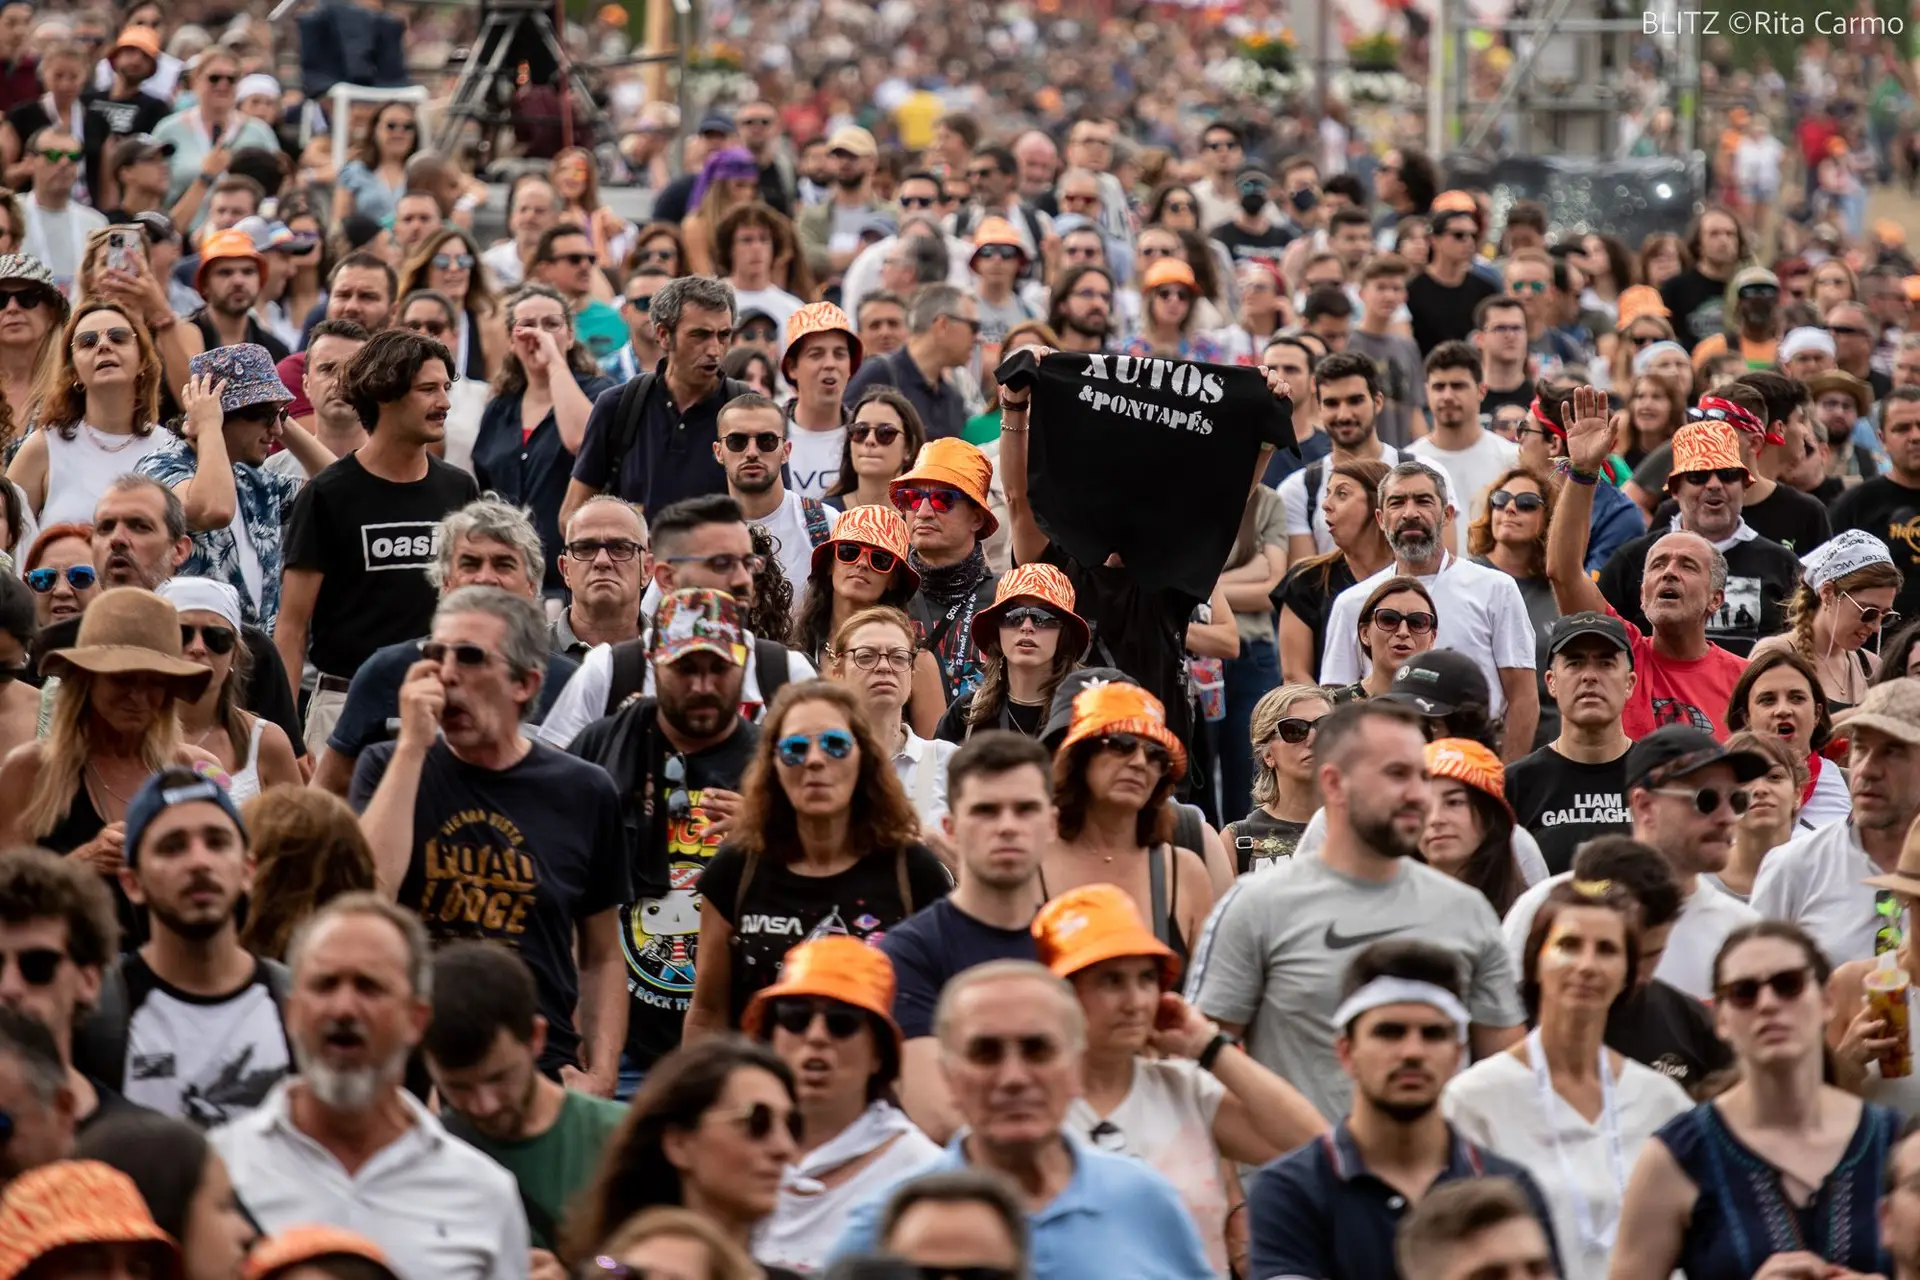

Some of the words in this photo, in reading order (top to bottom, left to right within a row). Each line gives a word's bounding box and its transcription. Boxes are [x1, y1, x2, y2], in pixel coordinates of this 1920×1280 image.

[1081, 353, 1224, 403] XUTOS
[1078, 385, 1214, 435] &PONTAPÉS
[371, 527, 441, 559] oasi
[1574, 793, 1622, 809] LIAM
[1541, 807, 1634, 827] GALLAGH
[421, 880, 537, 934] LODGE
[740, 914, 804, 936] NASA
[635, 985, 673, 1010] ROCK
